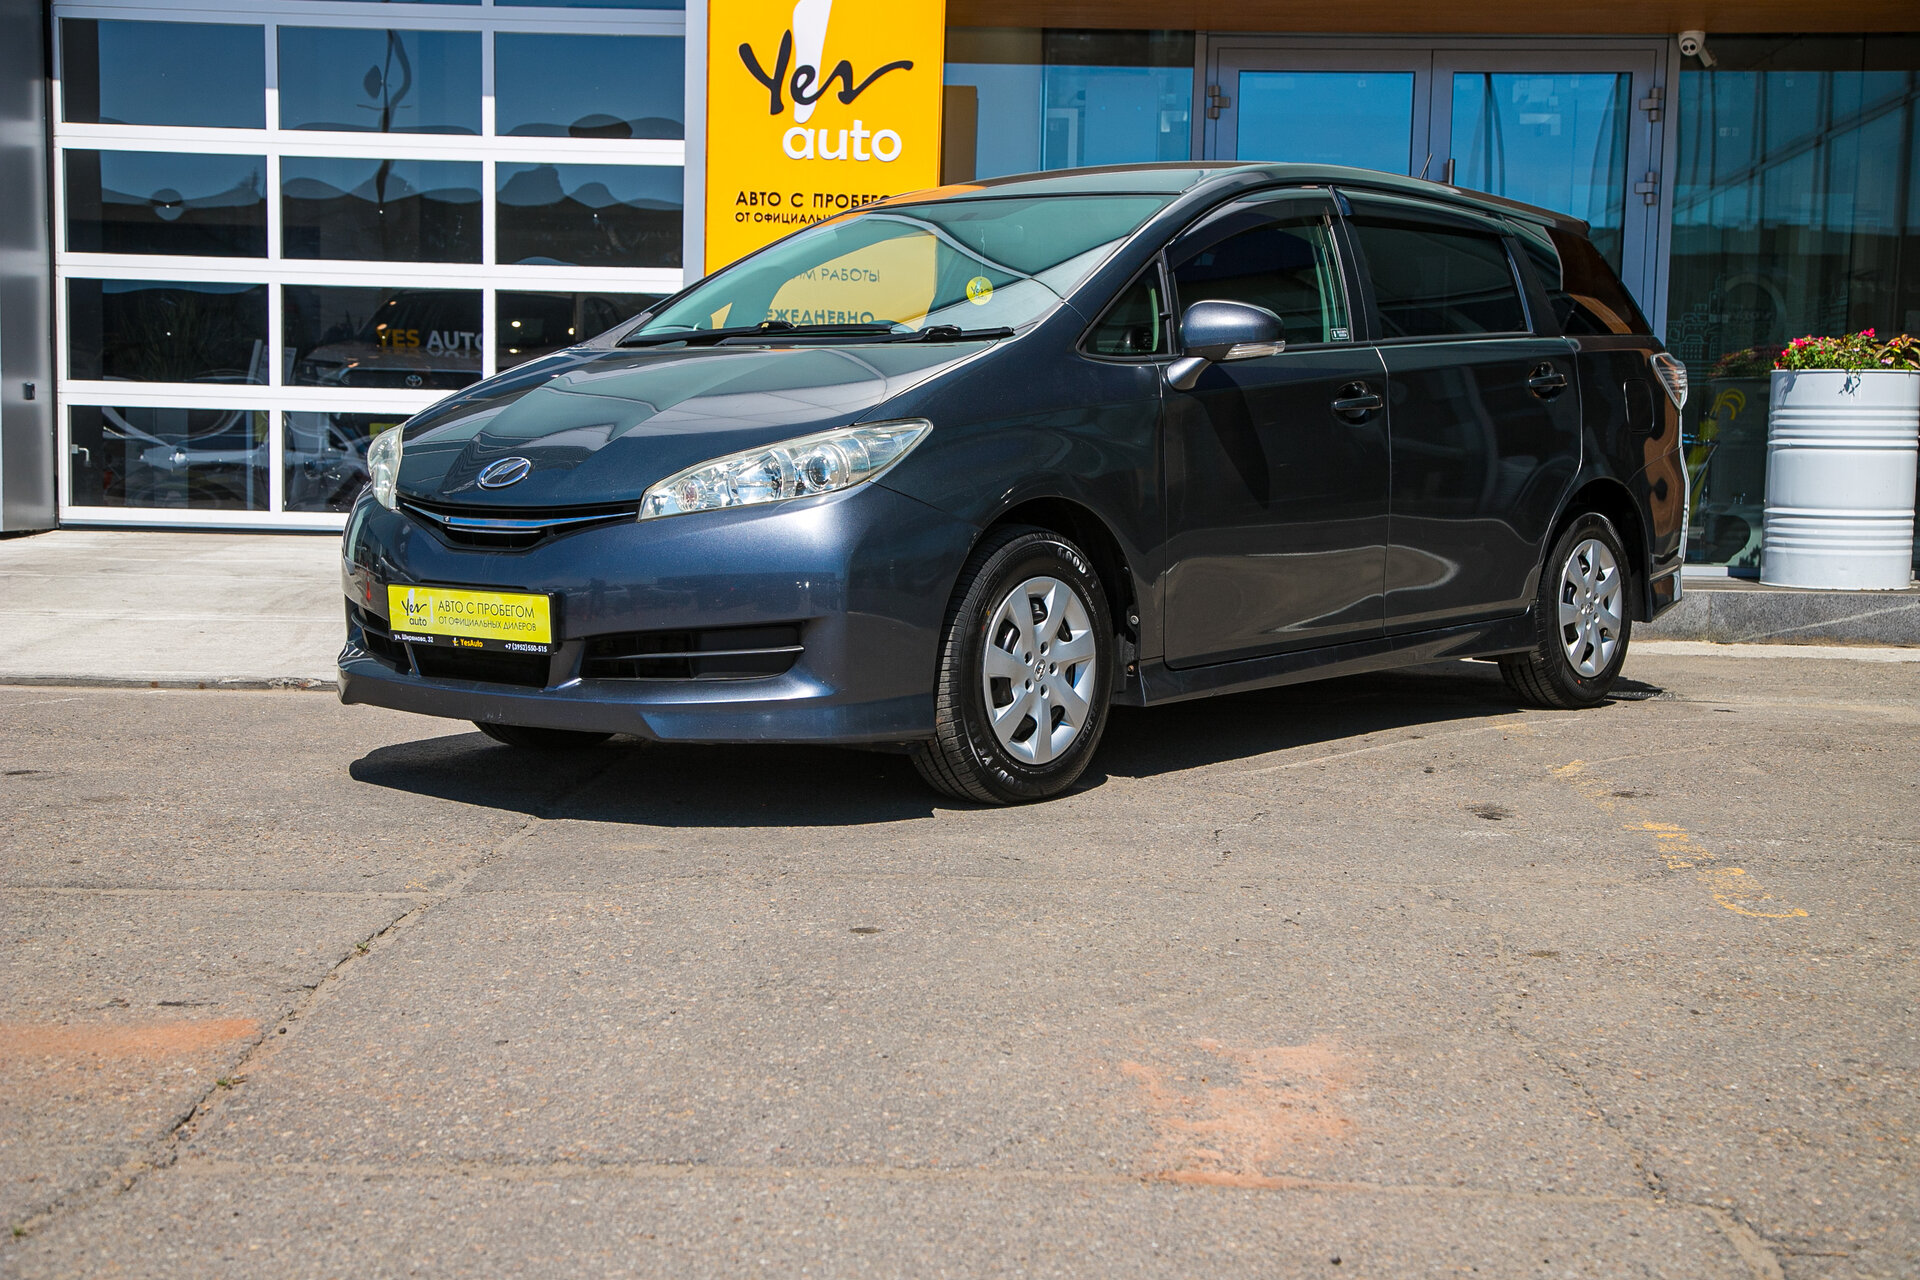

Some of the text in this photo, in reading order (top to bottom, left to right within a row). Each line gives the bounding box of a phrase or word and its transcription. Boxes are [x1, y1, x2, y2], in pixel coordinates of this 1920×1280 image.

[738, 29, 914, 115] Yes
[782, 119, 902, 162] auto
[735, 191, 781, 207] АВТО
[790, 193, 804, 208] С
[735, 212, 750, 222] ОТ
[821, 268, 880, 282] РАБОТЫ
[765, 309, 875, 325] ЕЖЕДНЕВНО
[376, 328, 420, 348] YES
[401, 598, 427, 616] Yes
[438, 600, 535, 618] АВТО С ПРОБЕГОМ
[409, 617, 427, 627] auto
[438, 616, 537, 632] ОТ ОФИЦИАЛЬНЫХ ДИЛЕРОВ
